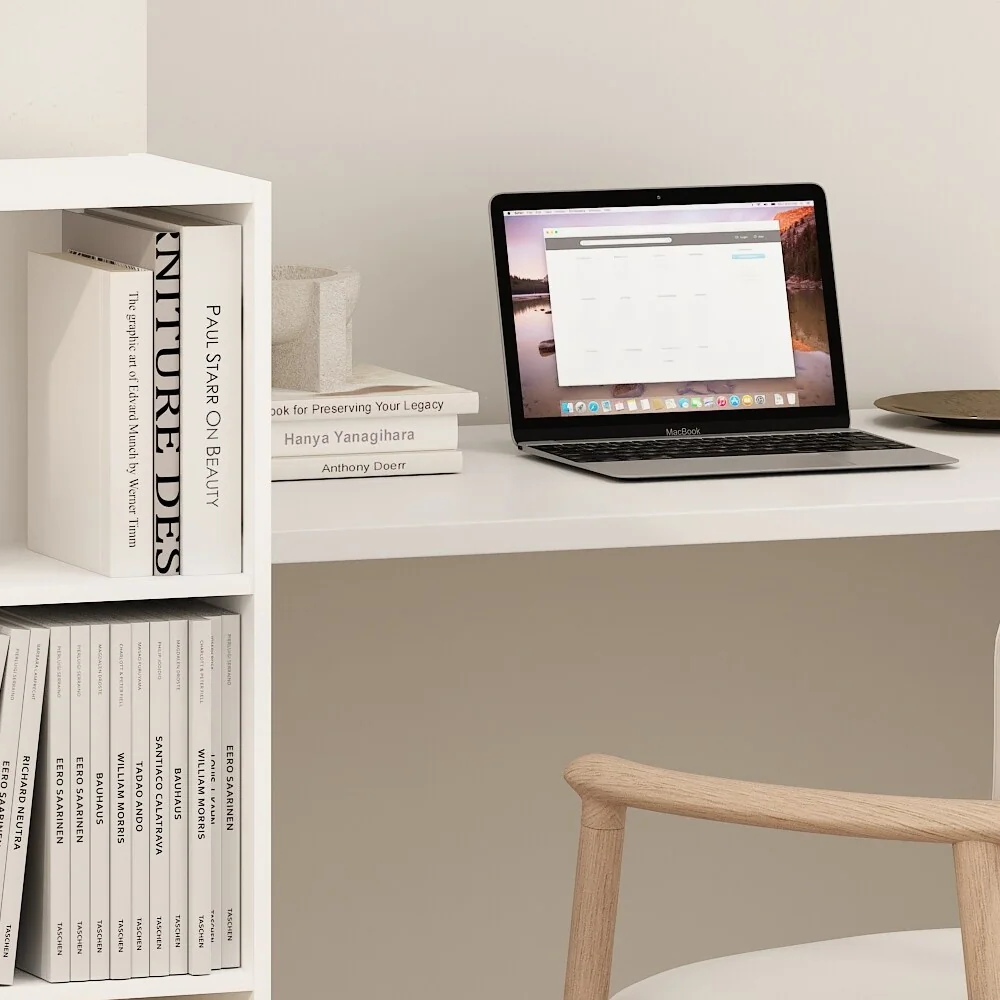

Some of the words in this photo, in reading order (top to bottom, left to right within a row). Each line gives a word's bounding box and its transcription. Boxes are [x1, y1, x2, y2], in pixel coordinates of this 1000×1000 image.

[129, 291, 139, 311] The
[126, 314, 139, 352] graphic
[129, 354, 138, 367] art
[129, 370, 139, 383] of
[129, 385, 139, 421] Edvard
[293, 404, 308, 415] for
[312, 403, 372, 414] Preserving
[375, 401, 400, 412] Your
[404, 400, 444, 412] Legacy
[129, 424, 139, 460] Munch
[284, 433, 329, 447] Hanya
[334, 429, 415, 445] Yanagihara
[665, 428, 701, 436] MacBook
[126, 463, 139, 475] by
[321, 463, 370, 474] Anthony
[374, 461, 406, 471] Doerr
[129, 479, 139, 514] Werner
[129, 517, 139, 548] Timm
[155, 474, 180, 575] DES
[0, 760, 10, 789] EERO
[56, 758, 64, 786] EERO
[76, 757, 84, 785] EERO
[117, 752, 125, 799] WILLIAM
[226, 745, 234, 773] EERO
[18, 755, 31, 803] RICHARD
[135, 761, 143, 798] TADAO
[174, 768, 182, 820] BAUHAUS
[76, 788, 84, 843] SAARINEN
[96, 772, 104, 825] BAUHAUS
[135, 800, 143, 832] ANDO
[226, 776, 234, 831] SAARINEN
[13, 806, 25, 850] NEUTRA
[56, 789, 64, 844] SAARINEN
[117, 802, 125, 844] MORRIS
[155, 793, 163, 855] CALATRAVA
[3, 924, 12, 958] TASCHEN
